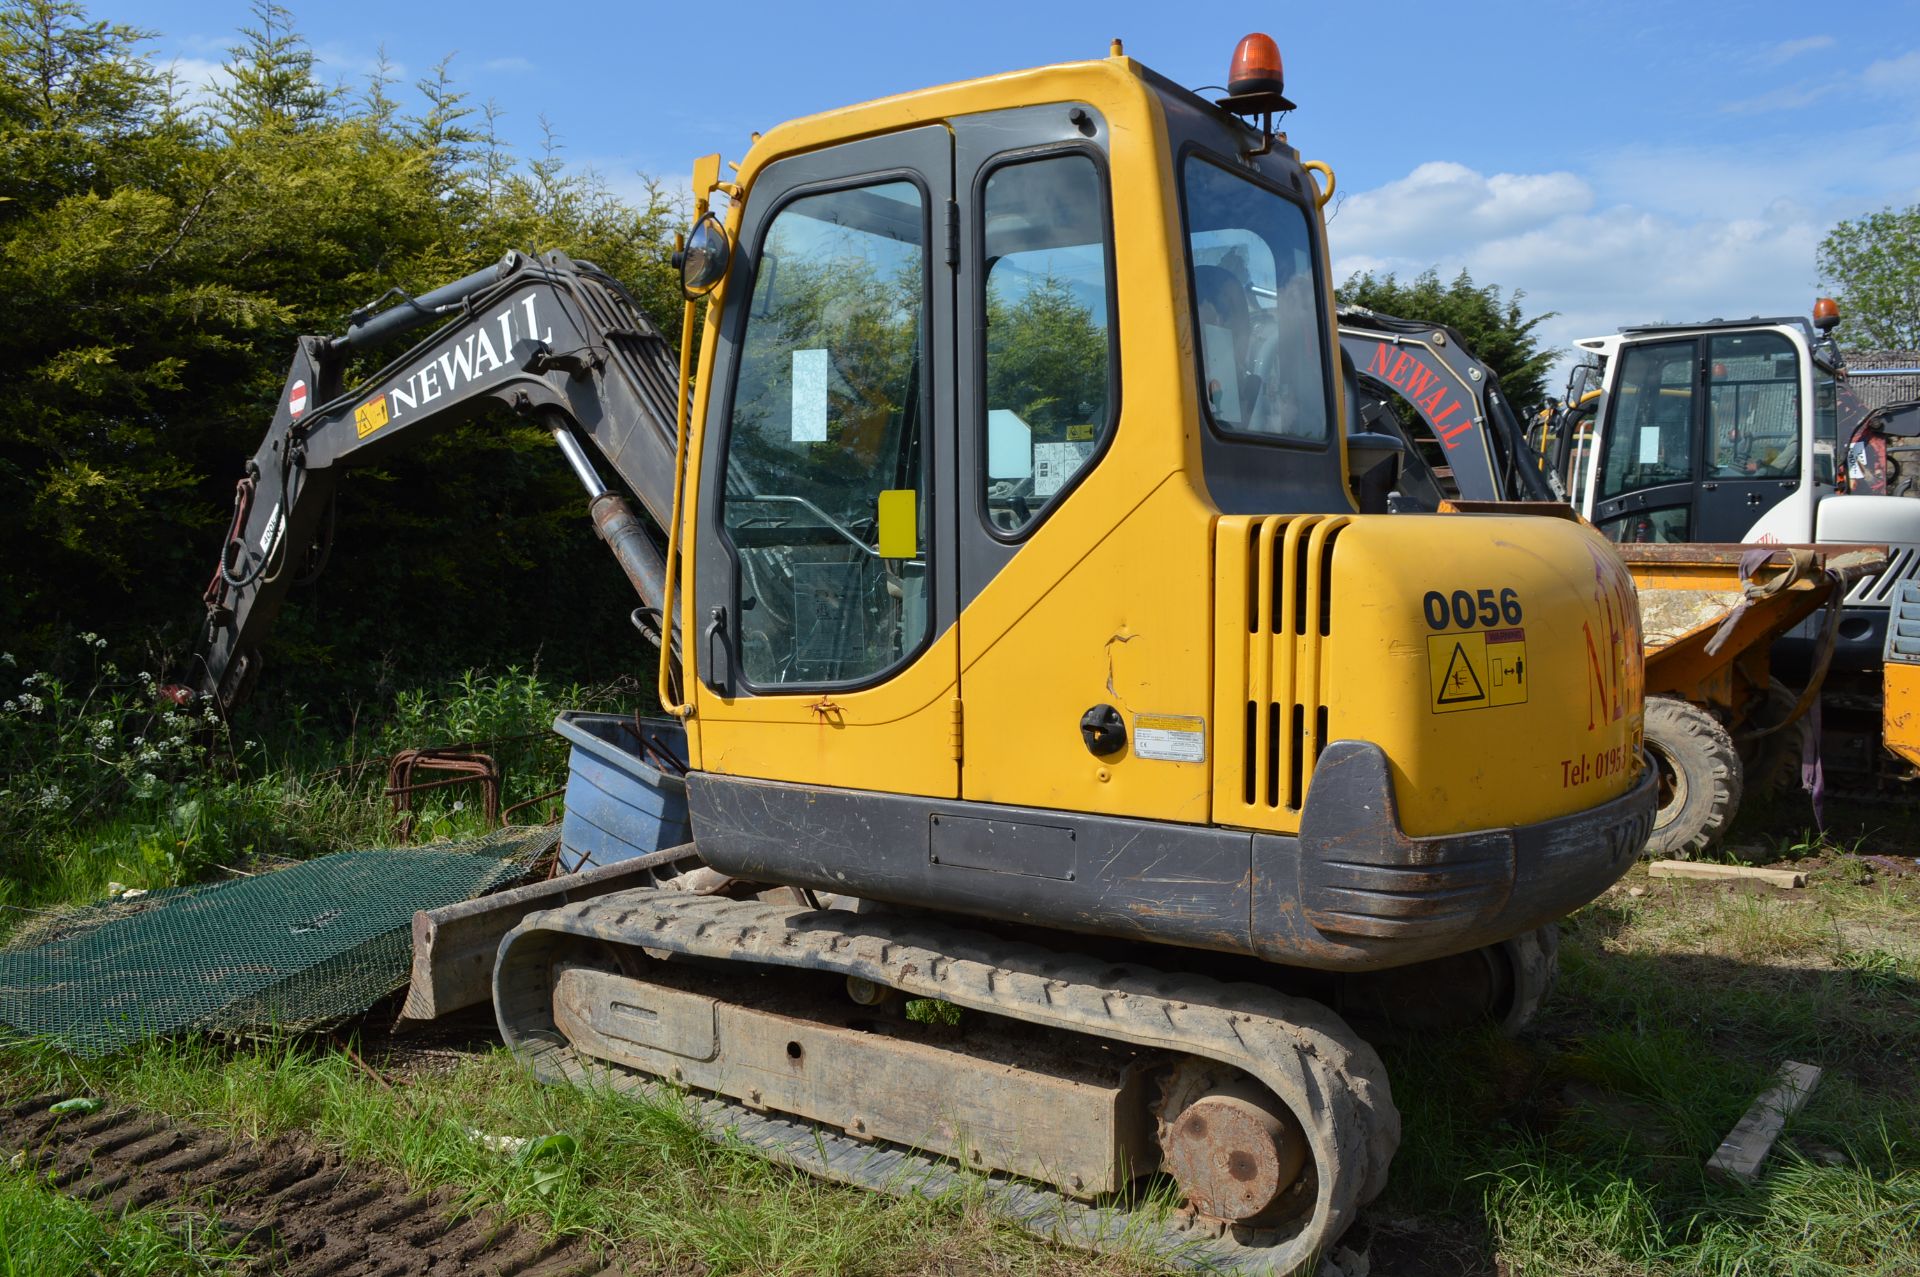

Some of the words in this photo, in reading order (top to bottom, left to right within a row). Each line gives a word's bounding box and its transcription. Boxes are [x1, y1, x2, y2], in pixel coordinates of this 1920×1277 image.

[389, 293, 552, 418] NEWALL
[1366, 342, 1473, 450] NEWALL
[1423, 588, 1522, 630] 0056
[1561, 753, 1590, 788] Tel:
